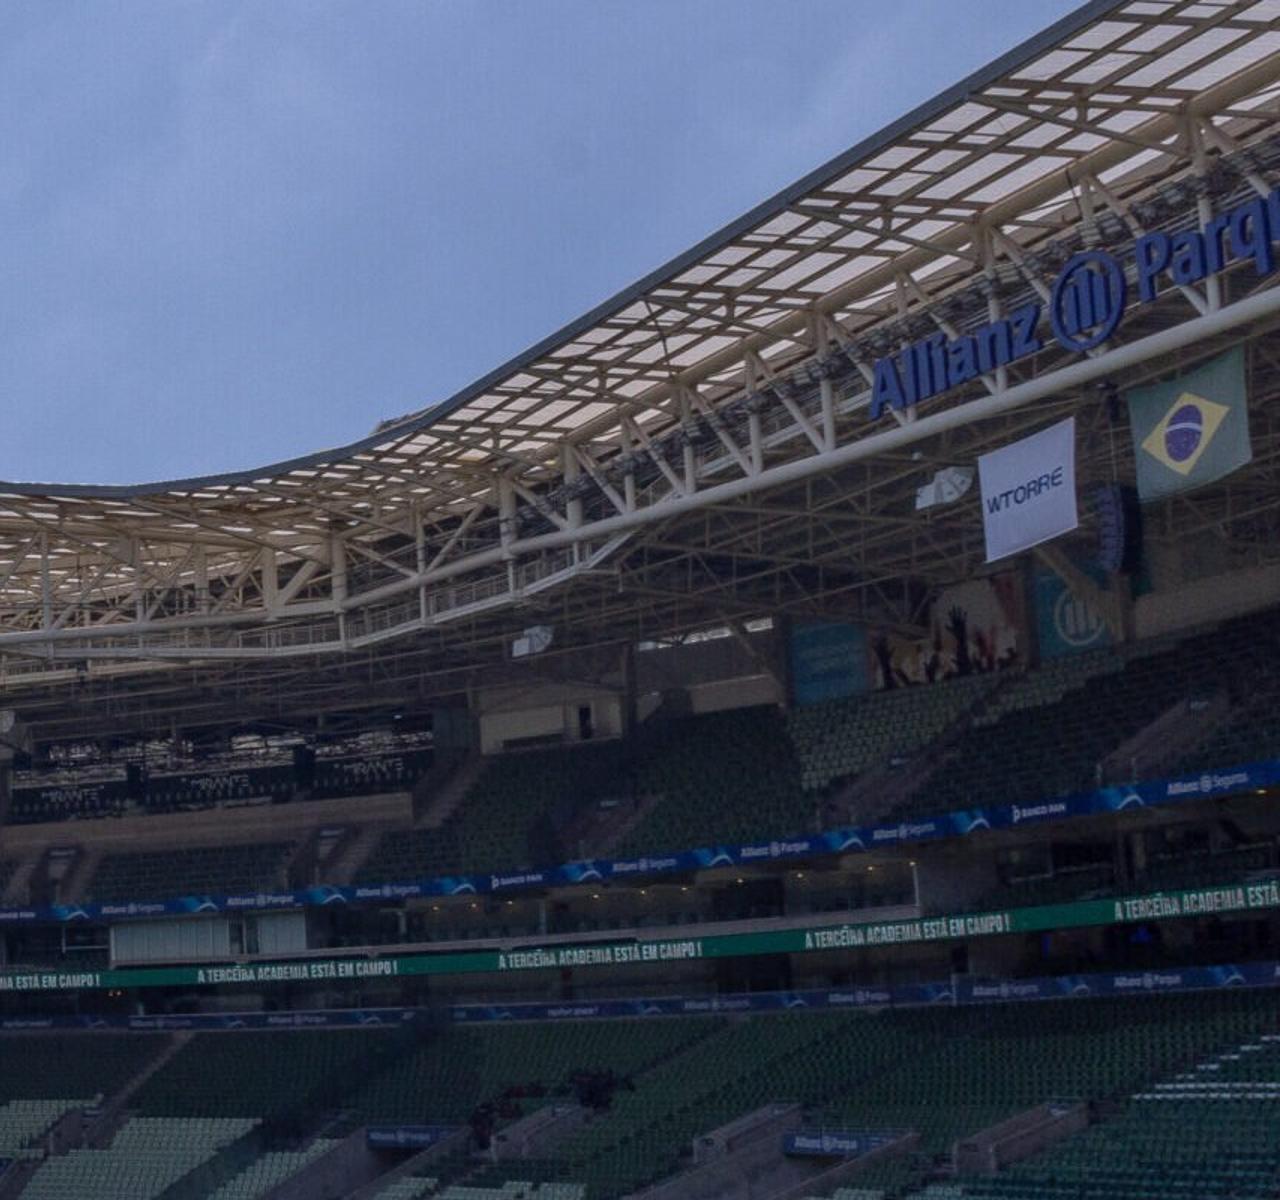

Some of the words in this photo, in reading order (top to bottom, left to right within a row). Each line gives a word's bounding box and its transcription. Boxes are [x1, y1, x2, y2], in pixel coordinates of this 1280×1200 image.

[871, 304, 1042, 421] Allianz
[987, 466, 1063, 513] WTORRE
[1114, 902, 1124, 920] A
[1183, 886, 1246, 912] ACADEMIA
[804, 934, 814, 949] A
[866, 923, 922, 944] ACADEMIA
[949, 920, 965, 936] EM
[967, 915, 1004, 934] CAMPO
[197, 969, 205, 983] A
[257, 965, 309, 981] ACADEMIA
[338, 963, 354, 977] EM
[356, 960, 391, 976] CAMPO
[499, 955, 507, 969] A
[558, 947, 613, 966] ACADEMIA
[643, 946, 658, 961] EM
[660, 942, 695, 959] CAMPO
[42, 975, 57, 988] EM
[59, 974, 93, 988] CAMPO
